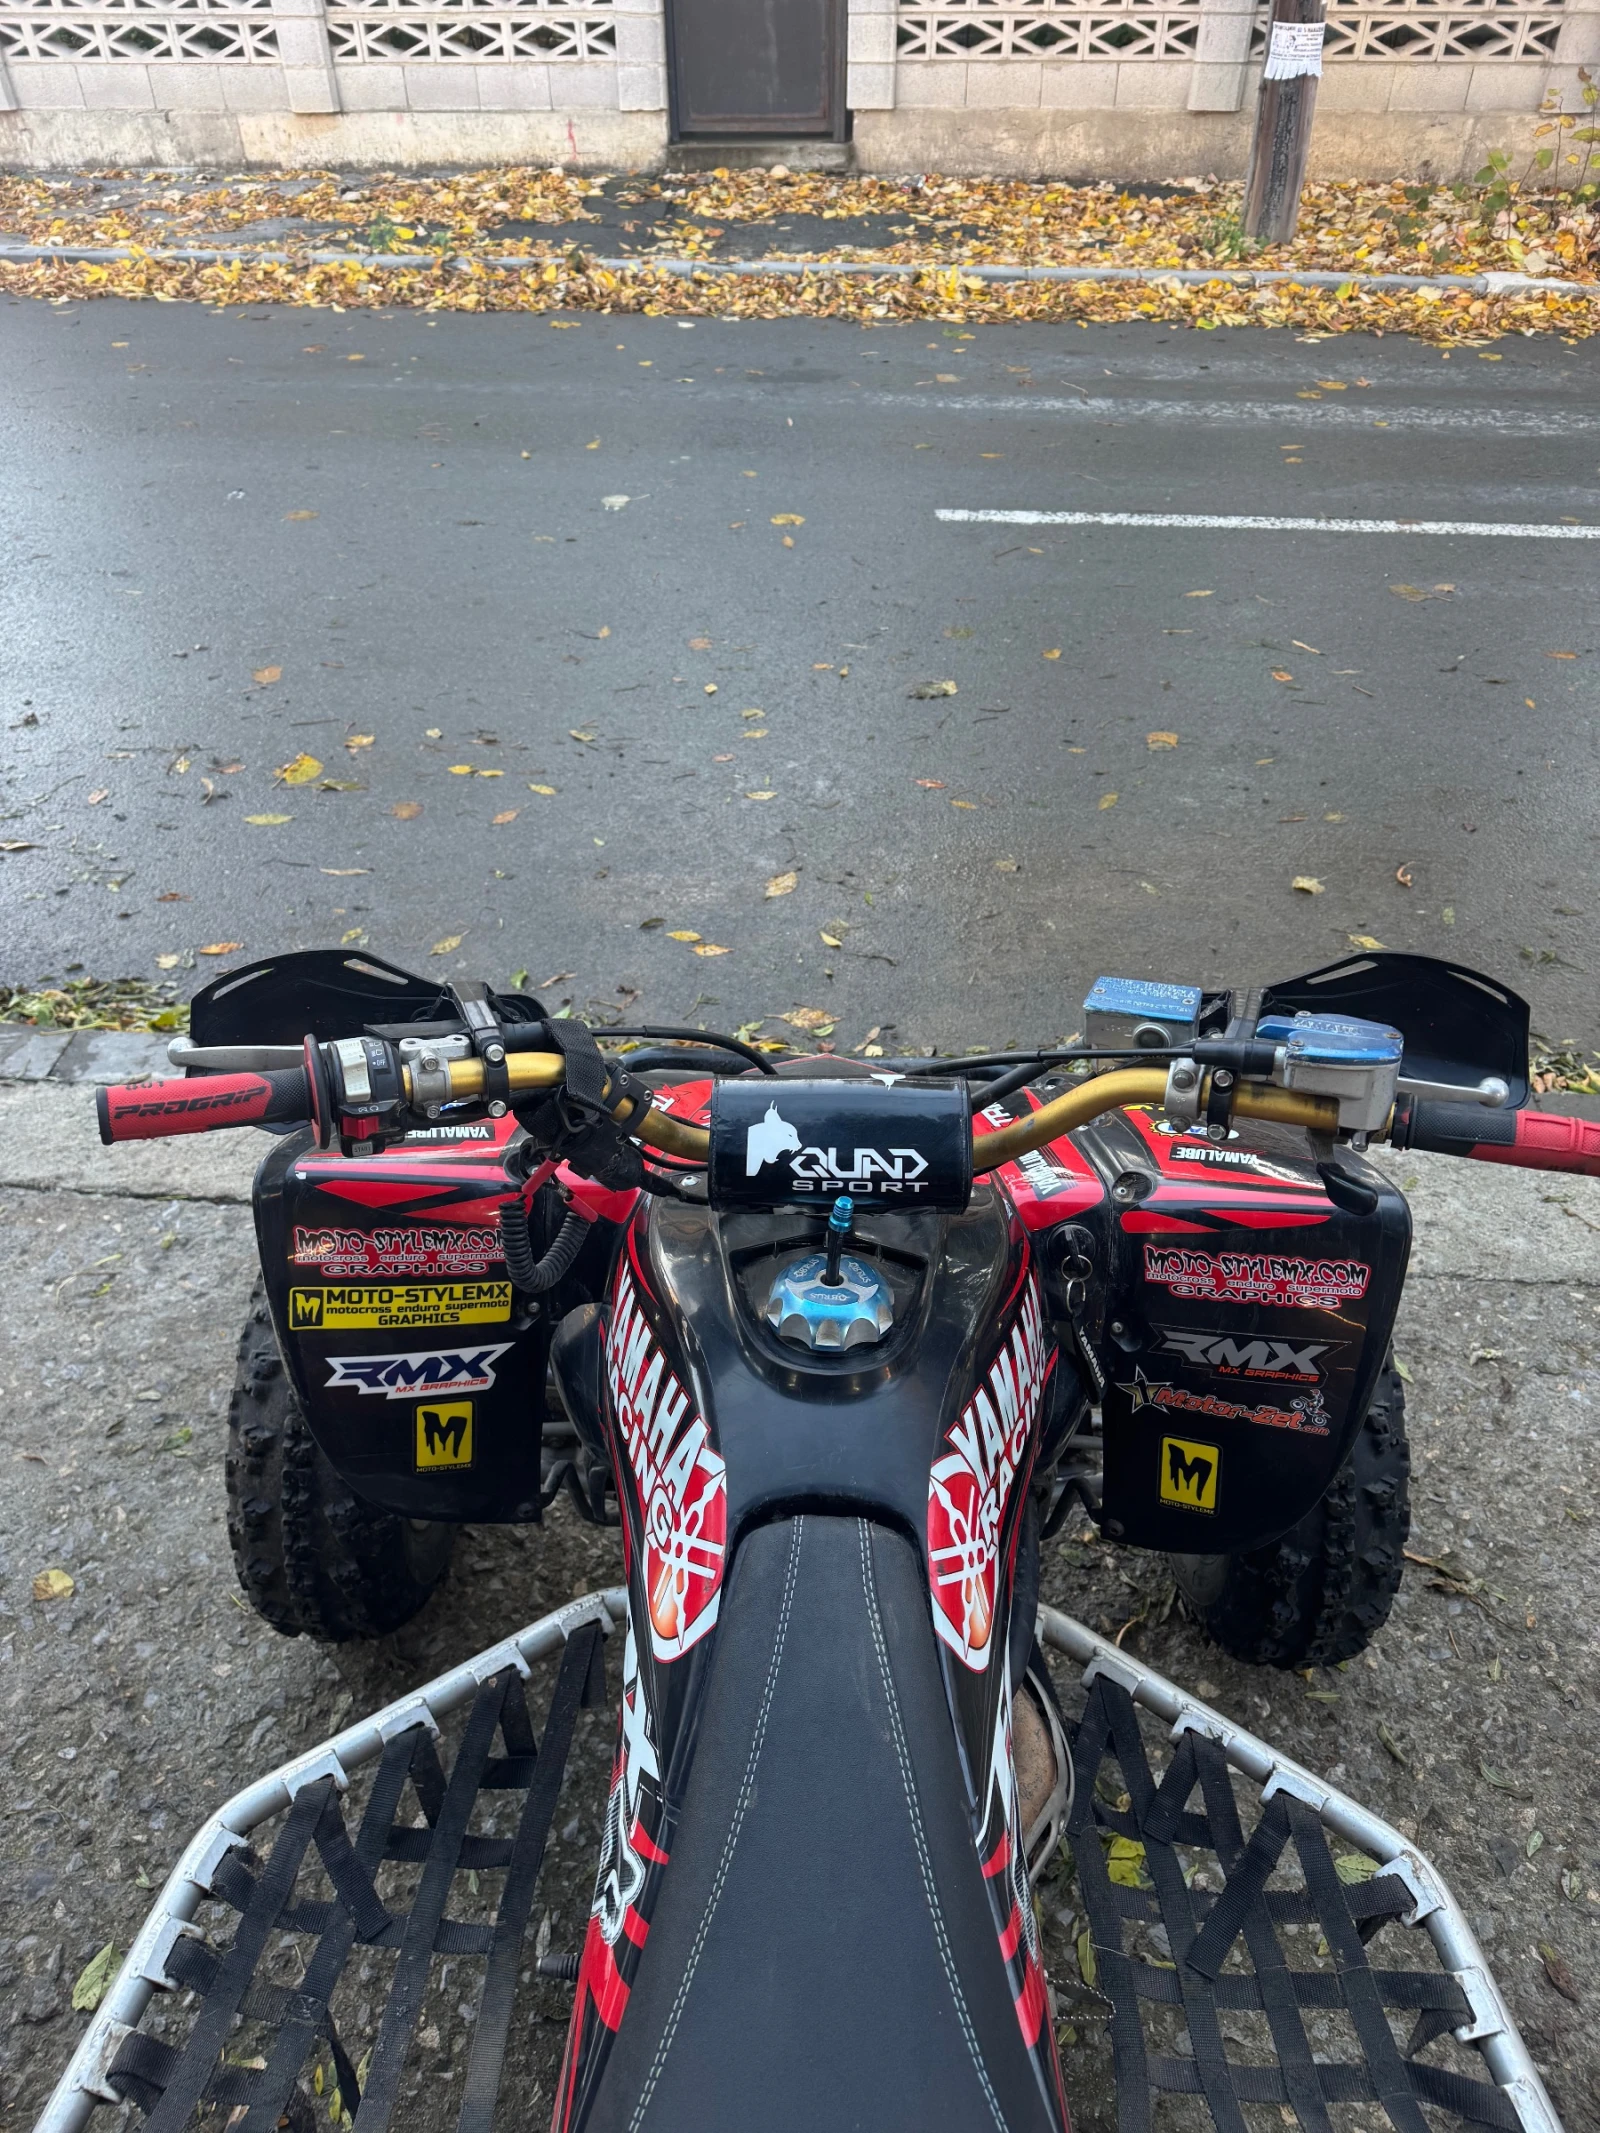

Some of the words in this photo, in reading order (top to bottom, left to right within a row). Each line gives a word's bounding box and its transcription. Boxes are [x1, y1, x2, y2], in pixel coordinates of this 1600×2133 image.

[376, 1058, 386, 1067] OFF
[789, 1147, 929, 1179] QUAD
[1175, 1147, 1257, 1164] YAMALUBE
[792, 1180, 929, 1192] SPORT
[298, 1253, 368, 1262] motocross
[380, 1253, 426, 1262] enduro
[323, 1262, 486, 1275] GRAPHICS
[1146, 1246, 1369, 1287] MOTO-STYLEMX.COM
[326, 1283, 510, 1305] MOTO-STYLEMX
[1147, 1271, 1215, 1285] motocross
[1227, 1280, 1276, 1290] enduro
[1287, 1284, 1362, 1296] supermoto
[326, 1305, 392, 1315] motocross
[397, 1304, 440, 1313] enduro
[445, 1299, 509, 1310] supermoto
[1171, 1284, 1340, 1308] GRAPHICS
[378, 1312, 460, 1326] GRAPHICS
[1161, 1331, 1330, 1375] RMX
[339, 1350, 498, 1388] RMX
[1218, 1366, 1240, 1375] MX
[1244, 1370, 1320, 1382] GRAPHICS
[419, 1378, 489, 1391] GRAPHICS
[612, 1257, 711, 1513] YAMAHA
[949, 1271, 1044, 1499] YAMAHA
[422, 1411, 468, 1458] M
[416, 1463, 472, 1472] MOTO-STYLEMX
[1168, 1443, 1213, 1501] M
